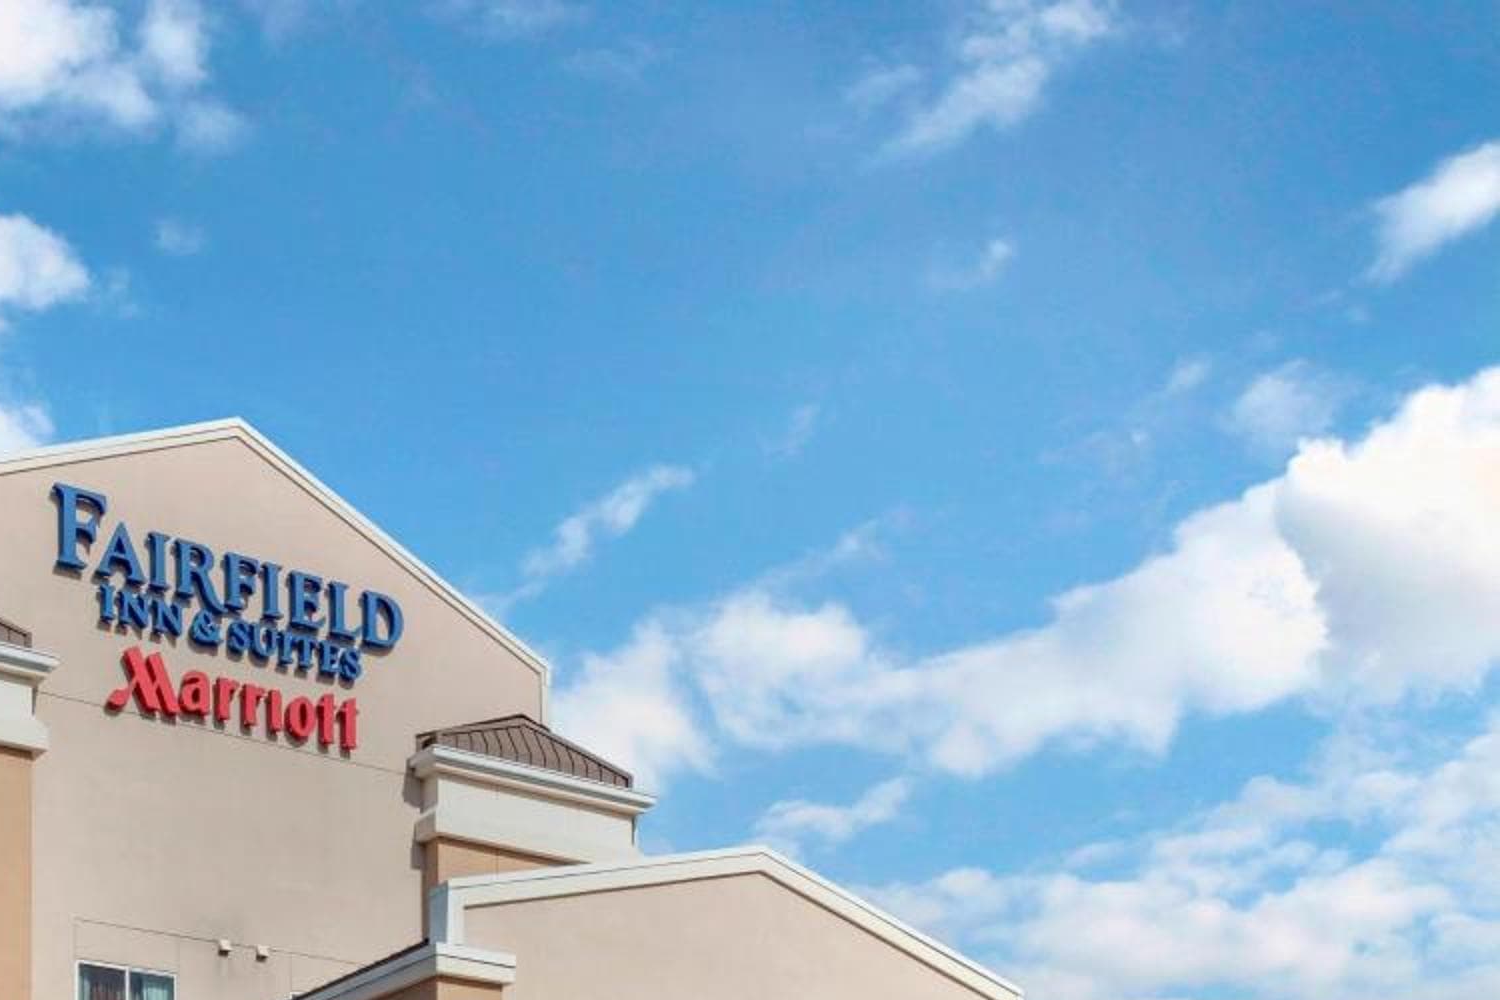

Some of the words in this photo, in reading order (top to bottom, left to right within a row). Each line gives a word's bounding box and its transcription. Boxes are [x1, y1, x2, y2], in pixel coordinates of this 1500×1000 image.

[52, 482, 403, 648] FAIRFIELD
[98, 583, 183, 638] INN
[190, 611, 222, 646] &
[227, 620, 362, 681] SUITES
[106, 646, 359, 751] Marriott
